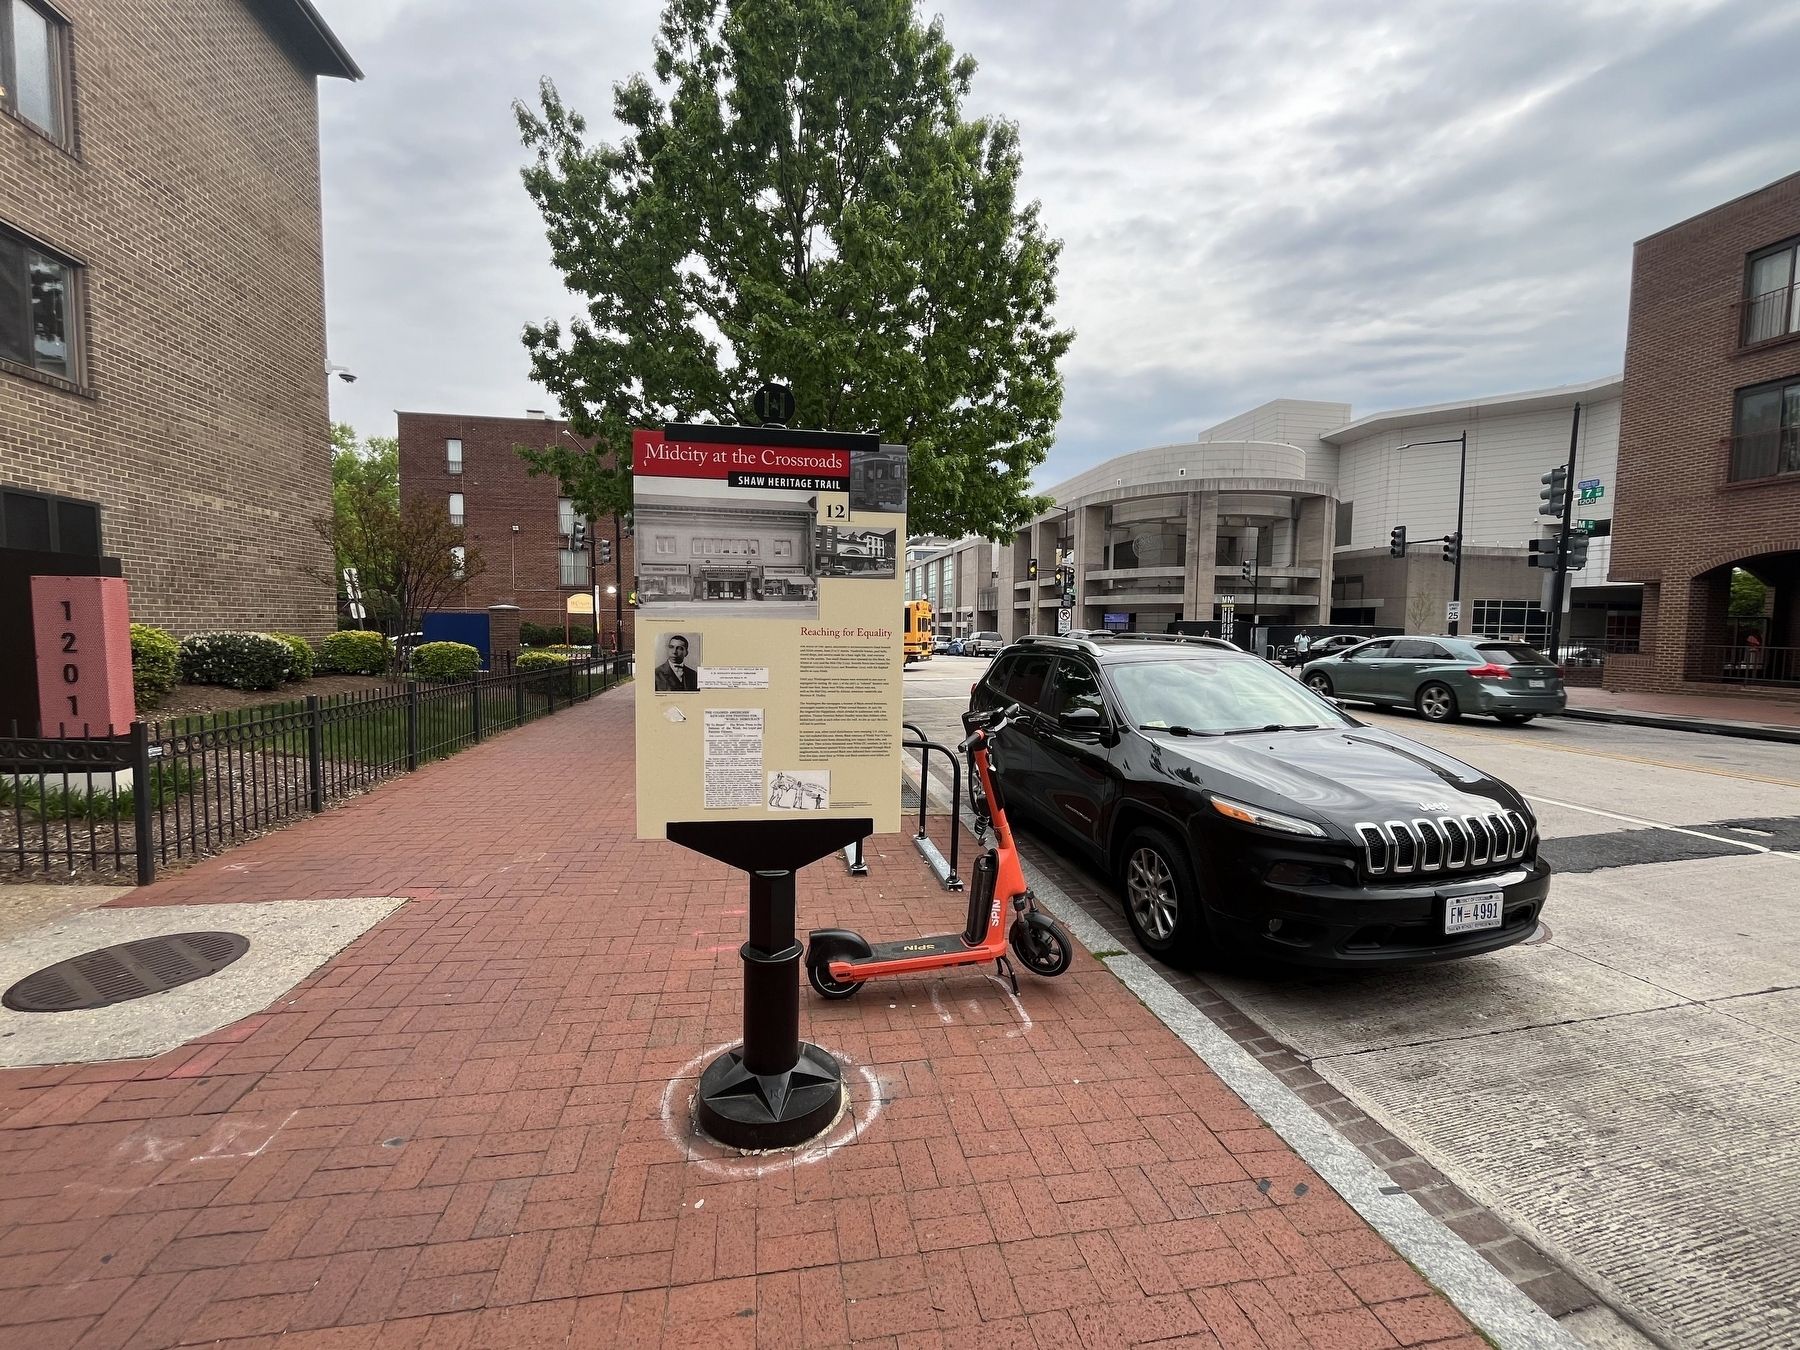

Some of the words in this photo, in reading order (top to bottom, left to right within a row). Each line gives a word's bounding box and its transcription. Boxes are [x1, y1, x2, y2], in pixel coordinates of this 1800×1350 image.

[645, 443, 708, 466] Midcity
[713, 451, 727, 463] at
[732, 449, 756, 465] the
[761, 450, 842, 469] Crossroads
[738, 476, 765, 487] SHAW
[768, 477, 812, 488] HERITAGE
[815, 480, 841, 490] TRAIL
[1586, 490, 1592, 498] 7
[826, 503, 846, 519] 12
[1448, 612, 1458, 620] 25
[800, 626, 840, 638] Reaching
[842, 627, 854, 638] for
[858, 628, 893, 640] Equality
[60, 601, 80, 716] 1201
[1418, 802, 1450, 812] Jeep
[990, 899, 1002, 927] SPIN
[1451, 906, 1463, 924] FM
[1473, 902, 1498, 920] 4991
